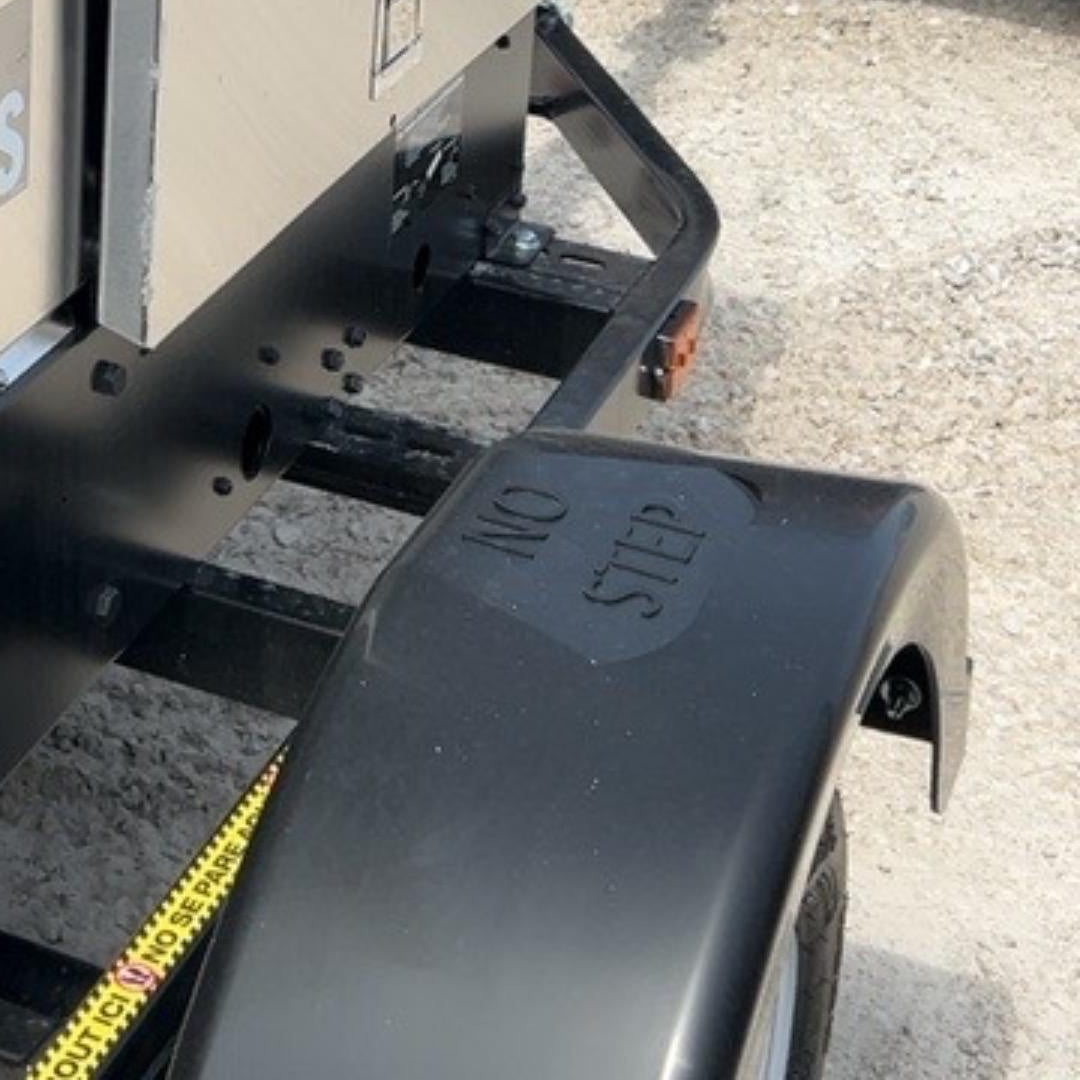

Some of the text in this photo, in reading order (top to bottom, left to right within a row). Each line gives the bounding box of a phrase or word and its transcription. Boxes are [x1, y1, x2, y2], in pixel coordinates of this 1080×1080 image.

[461, 486, 568, 560] NO
[582, 503, 706, 619] STEP
[142, 928, 179, 965] NO
[171, 898, 204, 928] SE
